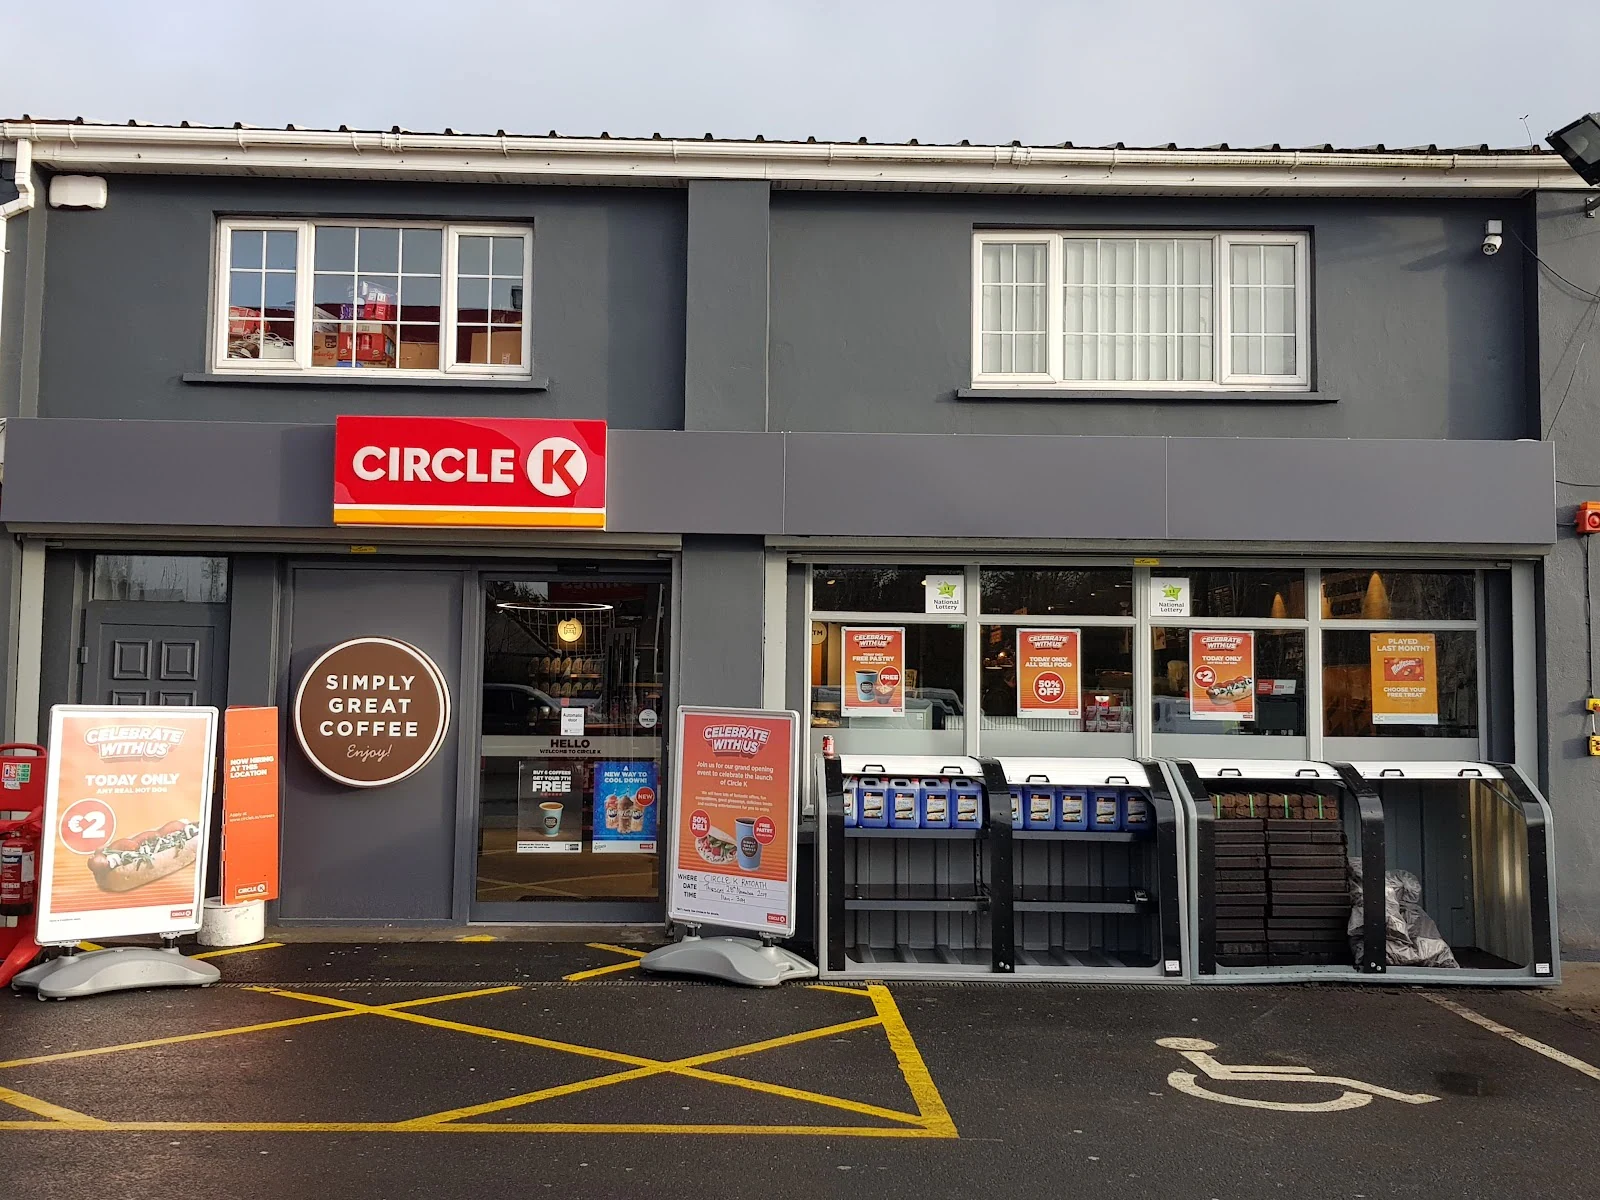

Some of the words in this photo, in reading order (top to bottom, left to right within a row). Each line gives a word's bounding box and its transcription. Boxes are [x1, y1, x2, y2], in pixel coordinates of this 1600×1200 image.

[352, 445, 515, 483] CIRCLE
[541, 446, 585, 496] K
[326, 674, 415, 690] SIMPLY
[328, 697, 412, 714] GREAT
[86, 727, 184, 744] CELEBRATE
[319, 720, 418, 737] COFFEE
[705, 726, 769, 742] CELEBRATE
[101, 742, 144, 757] WITH
[145, 742, 169, 756] US
[551, 739, 590, 748] HELLO
[713, 739, 741, 752] WITH
[742, 740, 758, 753] US
[347, 744, 393, 762] Enjoy!
[230, 758, 249, 766] NOW
[230, 769, 268, 779] LOCATION
[751, 766, 774, 774] opening
[85, 774, 137, 787] TODAY
[140, 773, 180, 786] ONLY
[532, 781, 571, 792] FREE
[68, 811, 106, 839] €2
[692, 816, 708, 824] 50%
[692, 823, 707, 831] DELI
[678, 873, 698, 881] WHERE
[704, 874, 730, 885] CIRCLE
[741, 879, 768, 890] RATOATH
[238, 886, 257, 894] CIRCLE
